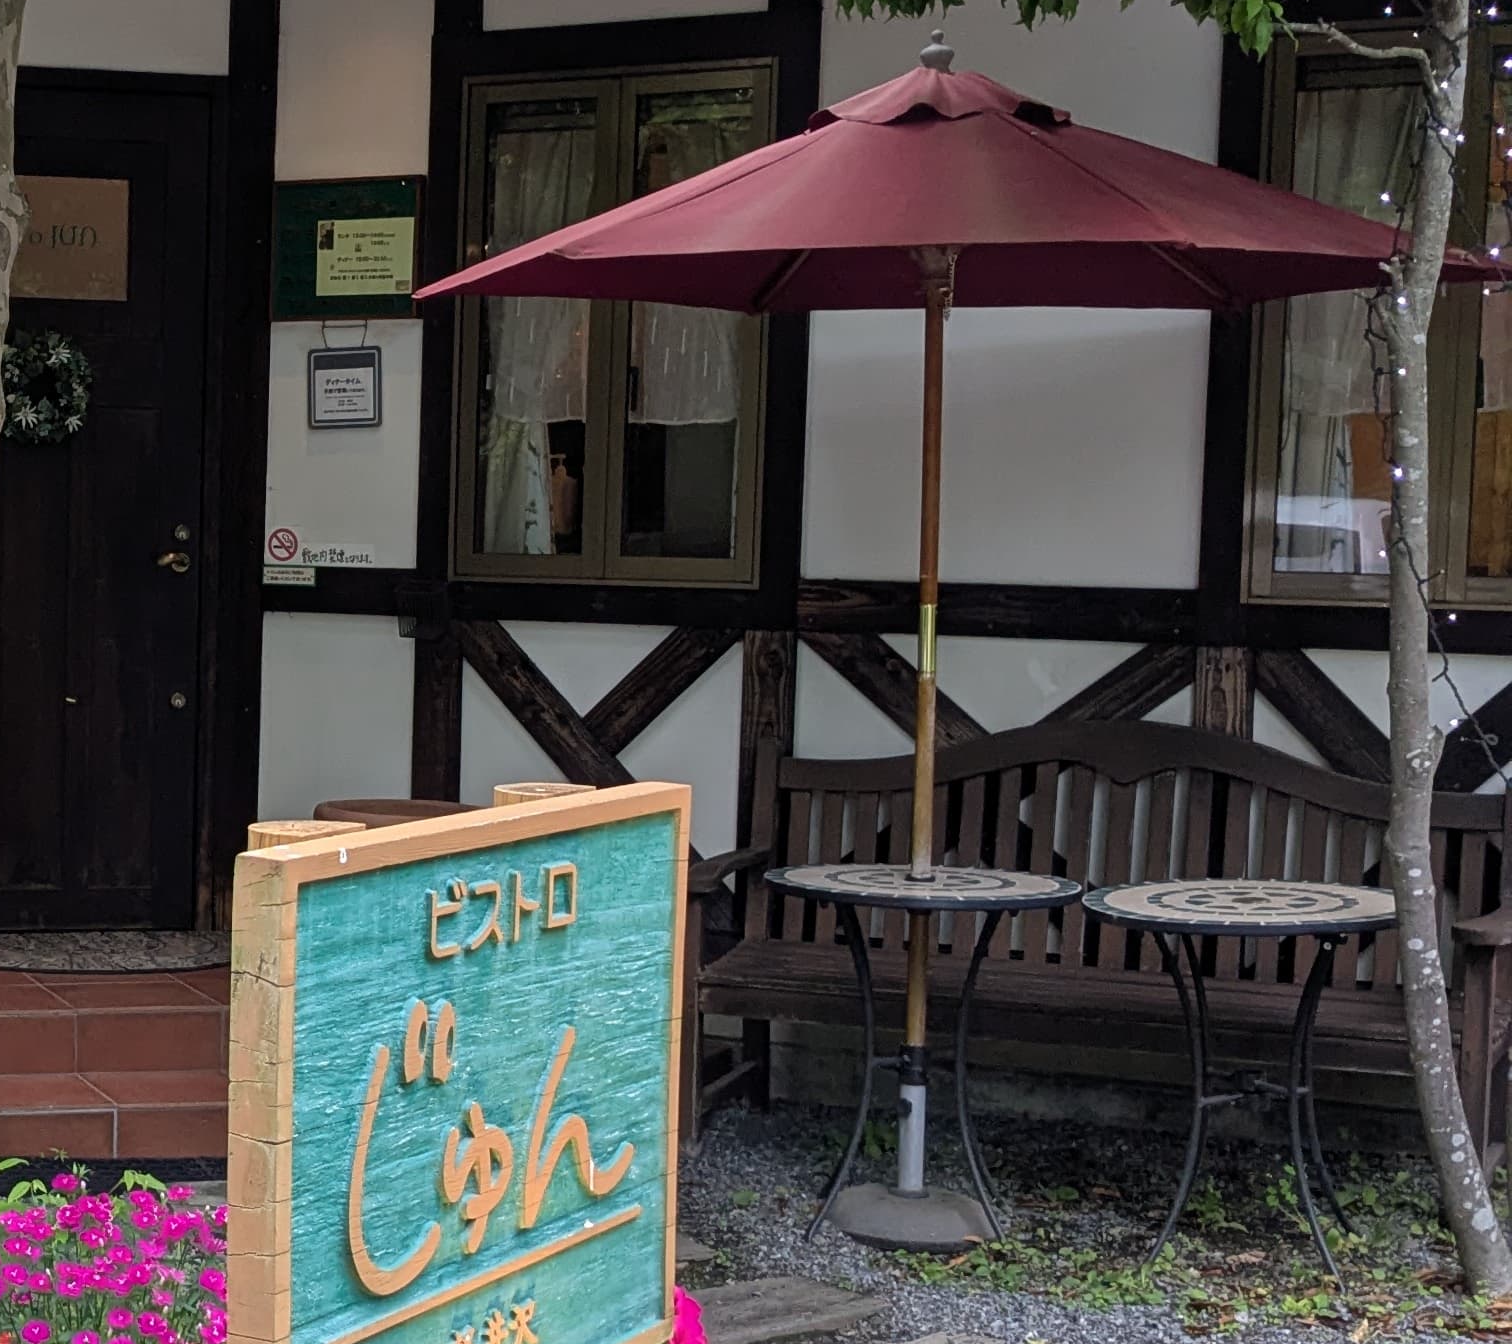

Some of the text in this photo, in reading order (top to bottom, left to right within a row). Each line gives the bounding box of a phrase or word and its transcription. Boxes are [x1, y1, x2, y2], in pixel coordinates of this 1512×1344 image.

[425, 861, 577, 958] ビストロ
[347, 998, 636, 1297] じゅん
